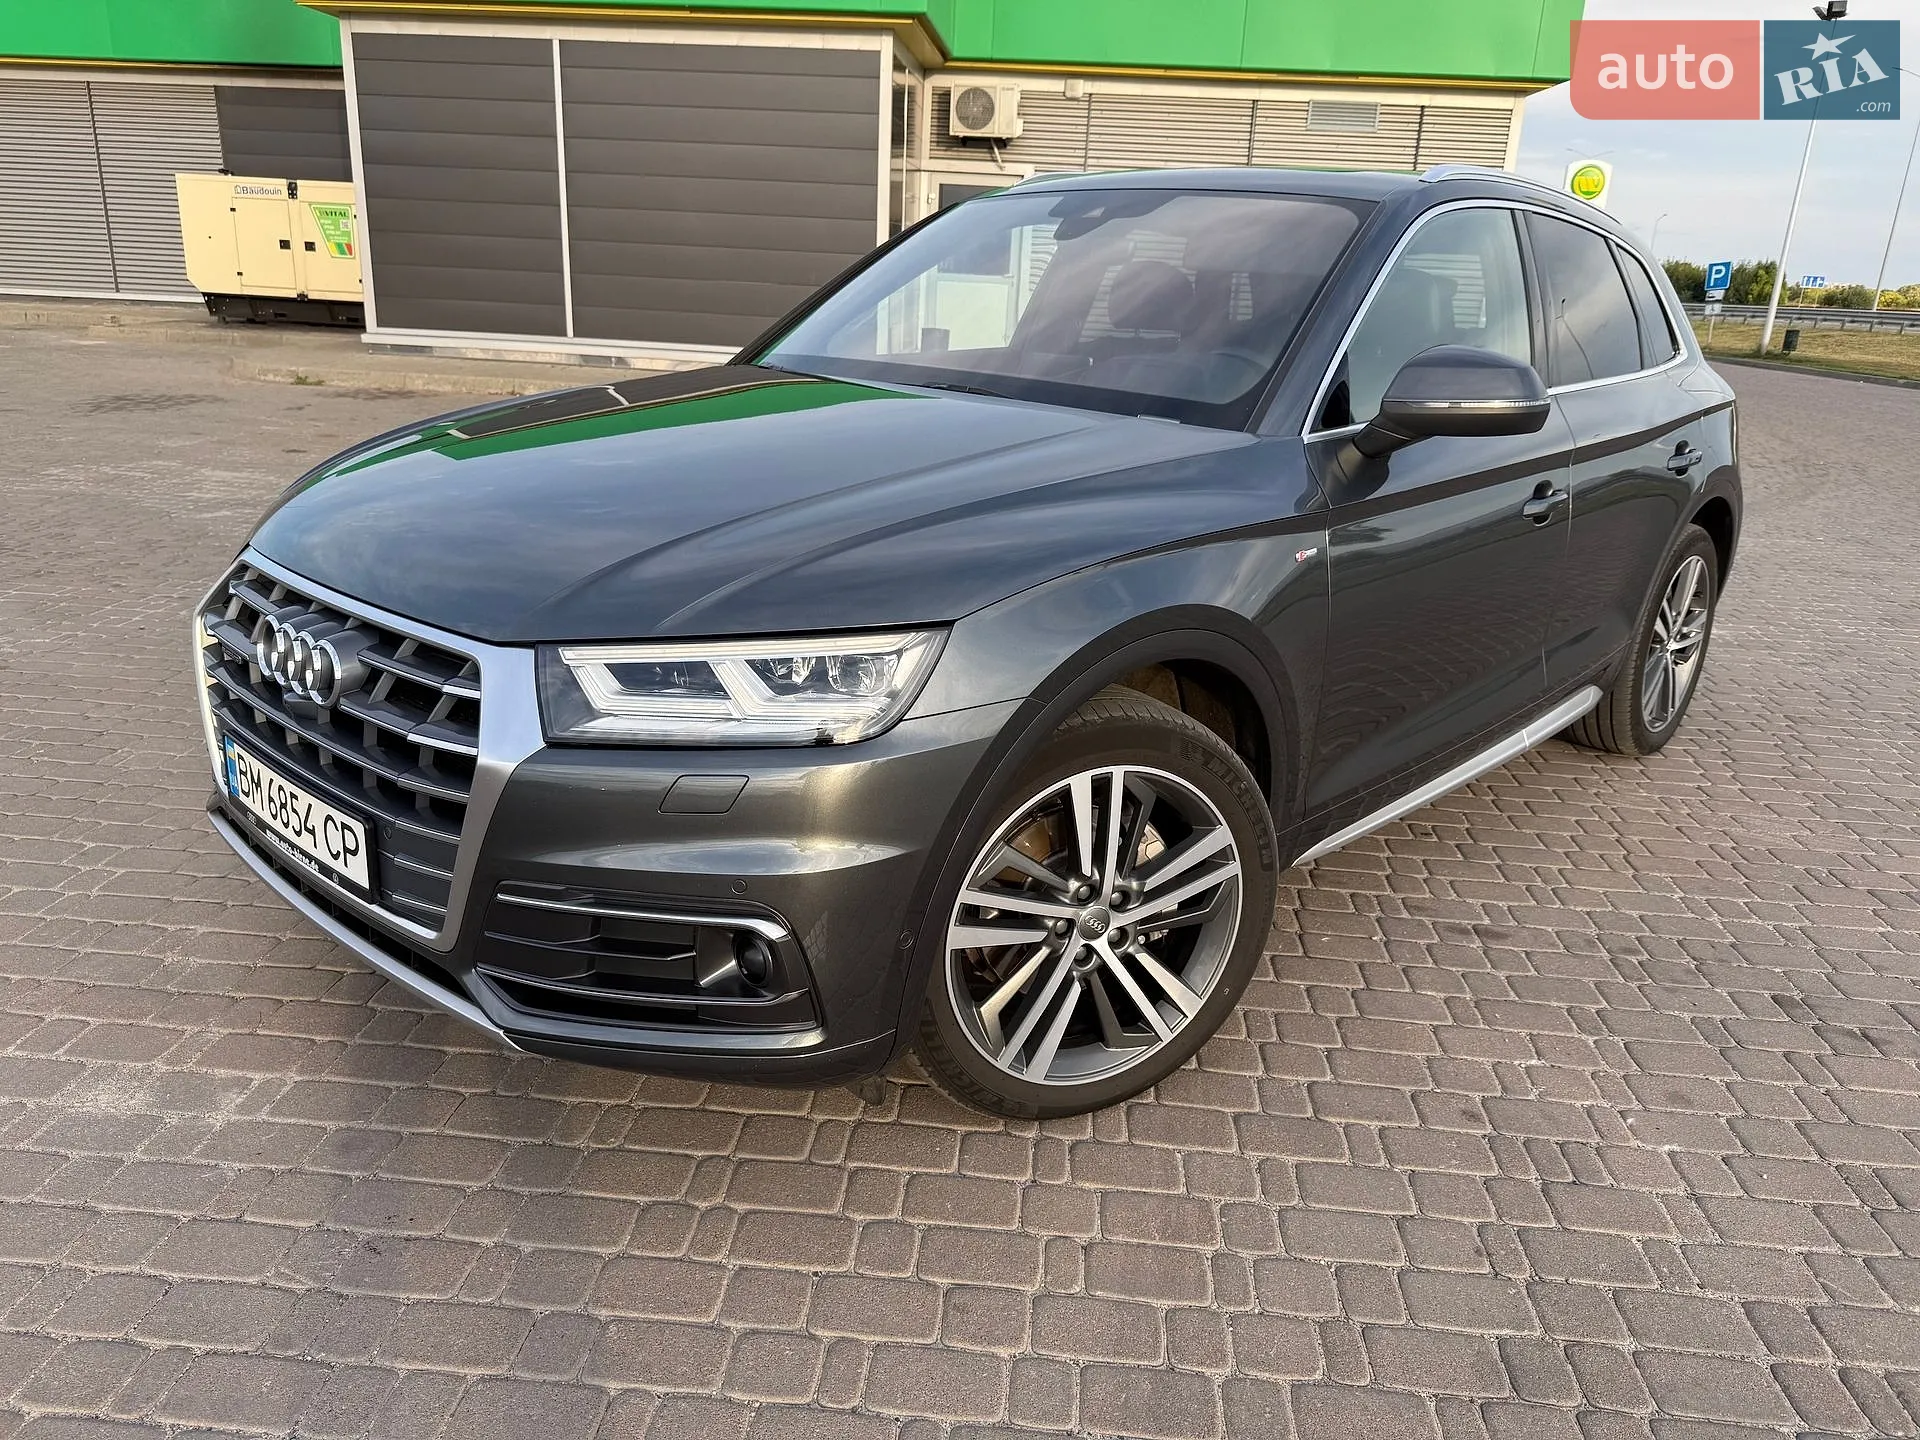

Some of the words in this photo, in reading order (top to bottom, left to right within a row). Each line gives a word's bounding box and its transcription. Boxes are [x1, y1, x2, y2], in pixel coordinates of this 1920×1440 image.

[242, 186, 282, 195] Baudouin
[1710, 265, 1726, 287] P
[236, 751, 265, 812] BM
[268, 777, 318, 850] 6854
[323, 813, 360, 869] CP
